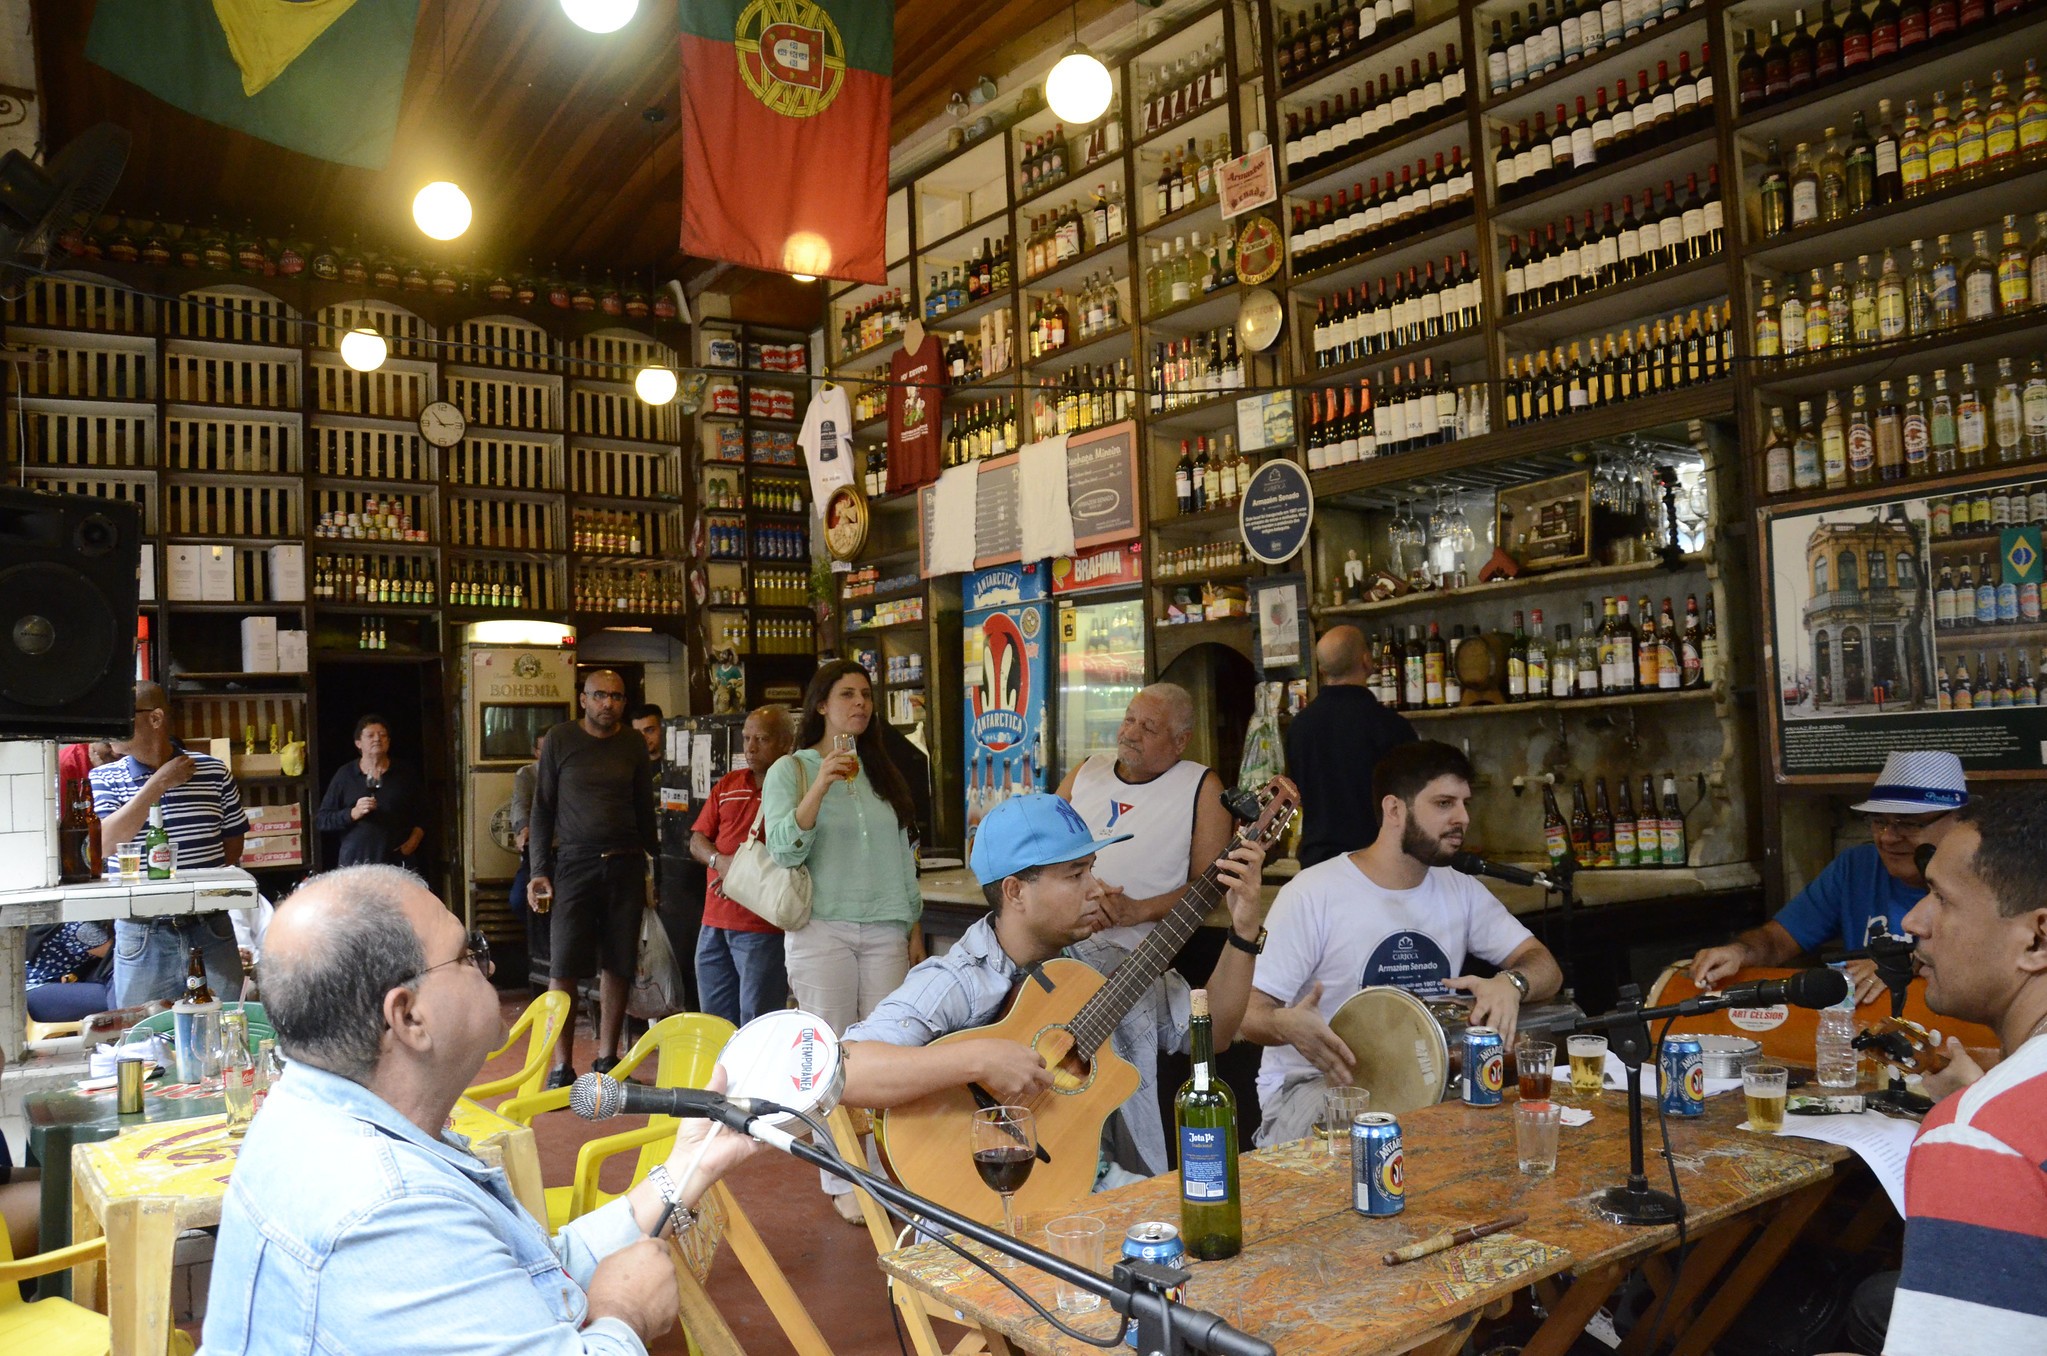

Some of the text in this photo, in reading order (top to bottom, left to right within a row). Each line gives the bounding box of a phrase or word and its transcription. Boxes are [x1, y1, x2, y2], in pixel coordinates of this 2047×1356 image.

[1252, 496, 1278, 507] Armazém
[1278, 492, 1300, 502] Senado
[1074, 550, 1122, 582] BRAHMA
[976, 571, 1019, 595] ANTARCTICA
[489, 683, 561, 698] BOHEMIA
[976, 712, 1023, 736] ANTARCTICA
[1378, 961, 1438, 973] Armazém Senado
[1731, 1010, 1784, 1020] ART CELSIOR
[800, 1028, 814, 1092] CONTEMPORÂNEA
[1189, 1132, 1205, 1142] Jota
